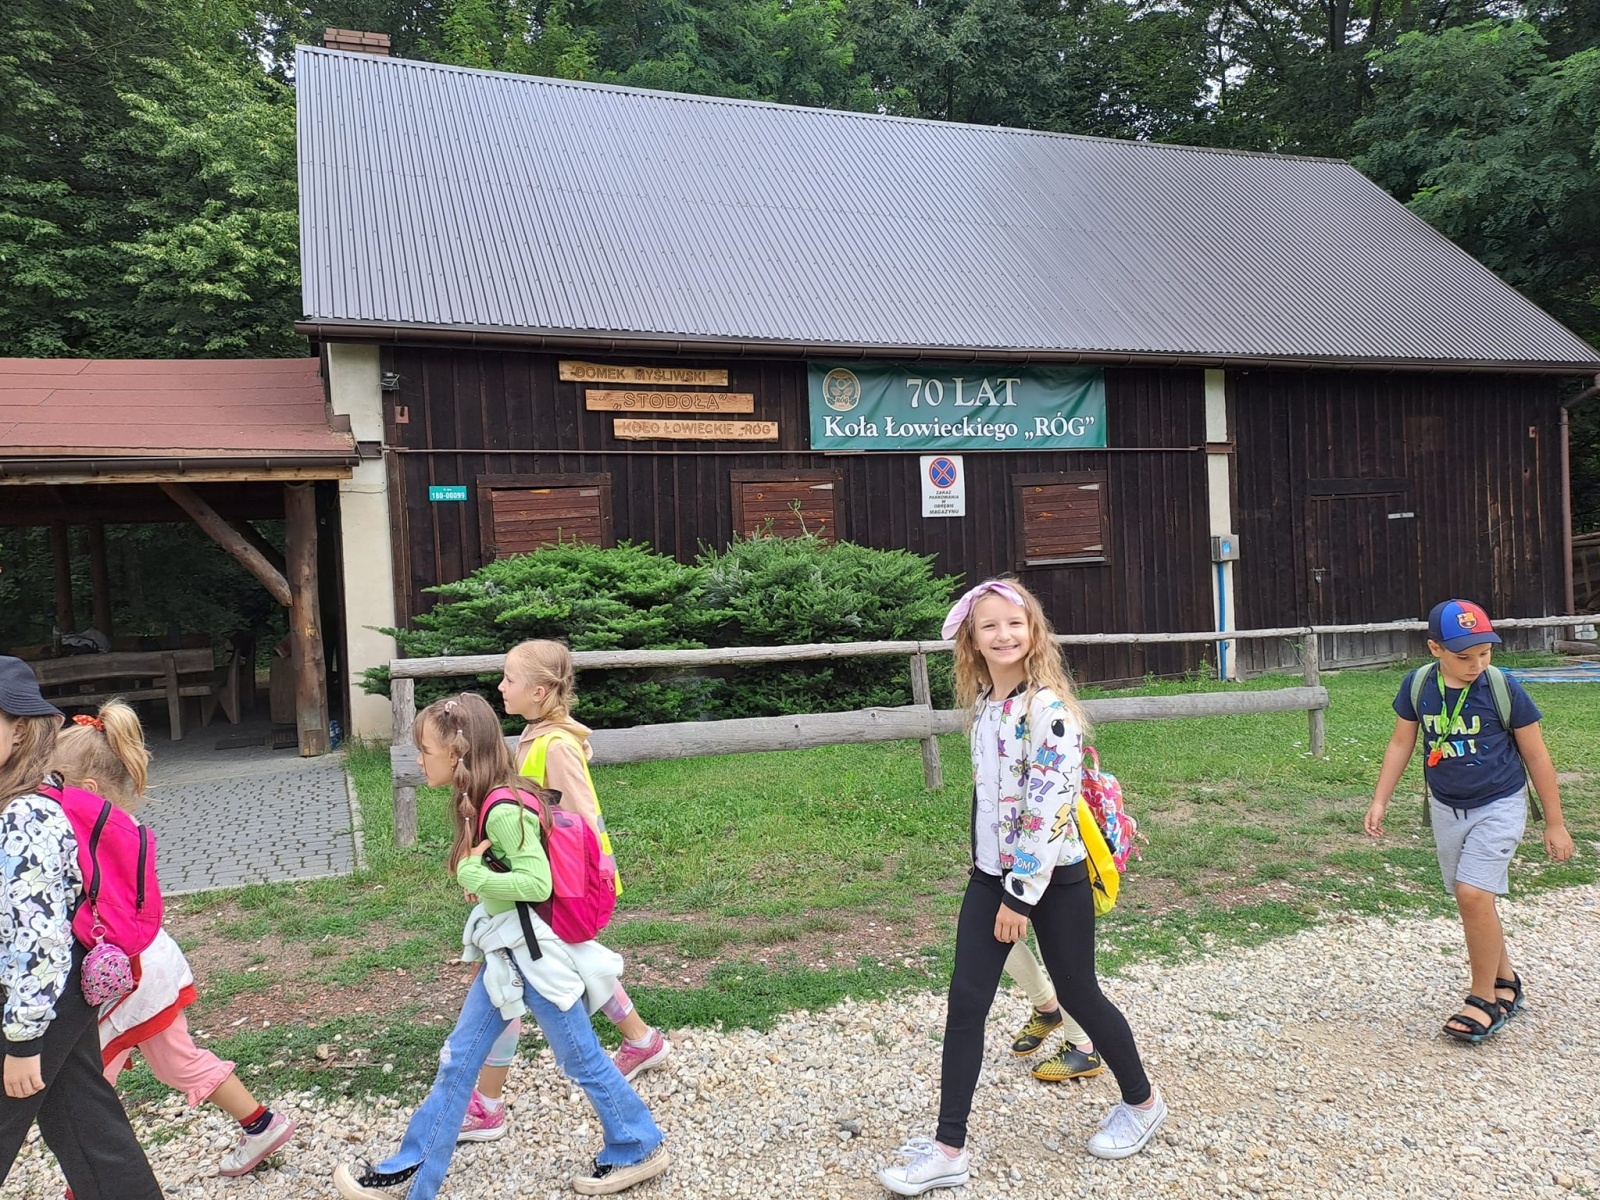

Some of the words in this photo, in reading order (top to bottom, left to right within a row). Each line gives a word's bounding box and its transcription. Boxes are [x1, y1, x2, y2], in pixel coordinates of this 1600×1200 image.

[575, 366, 626, 380] DOMEK
[906, 378, 944, 408] 70
[951, 377, 1021, 407] LAT
[622, 420, 660, 434] KOŁO
[823, 415, 879, 437] Koła
[885, 416, 1018, 441] Łowieckiego
